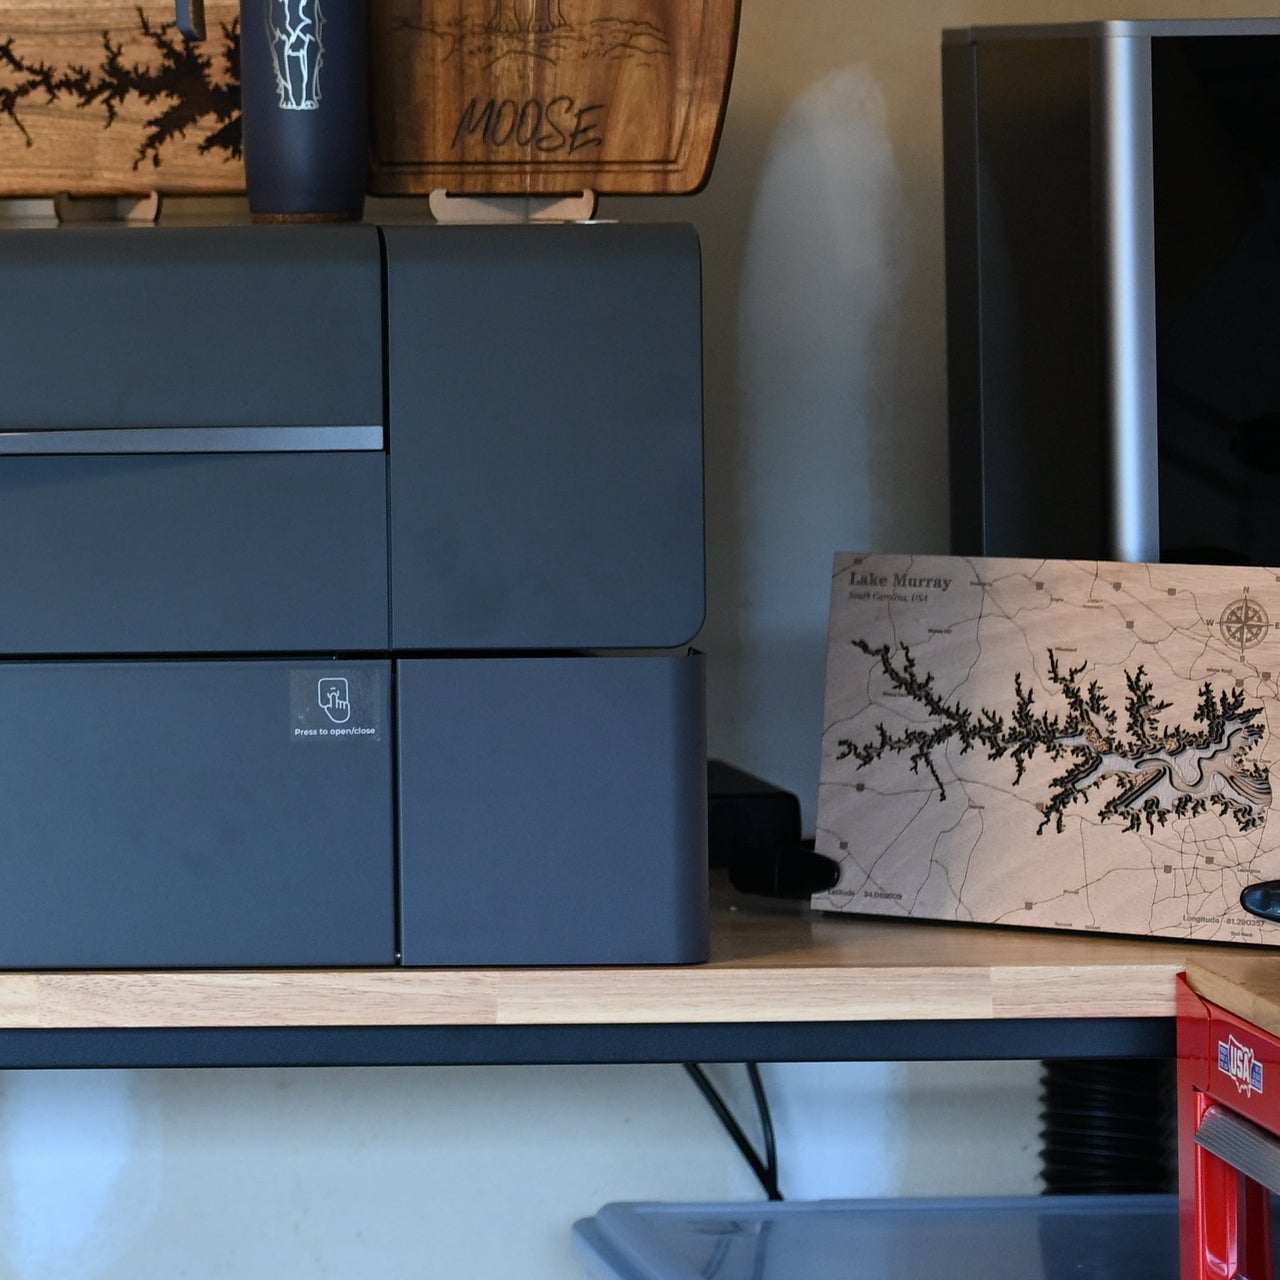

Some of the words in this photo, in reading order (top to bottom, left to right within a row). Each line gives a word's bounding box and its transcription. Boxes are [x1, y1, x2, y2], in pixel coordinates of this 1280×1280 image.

[451, 94, 605, 155] MOOSE
[849, 572, 888, 587] Lake
[893, 573, 953, 592] Murray
[1206, 619, 1215, 627] W
[1239, 655, 1246, 663] S
[294, 728, 318, 736] Press
[329, 726, 376, 737] open/close
[1230, 1045, 1250, 1083] USA
